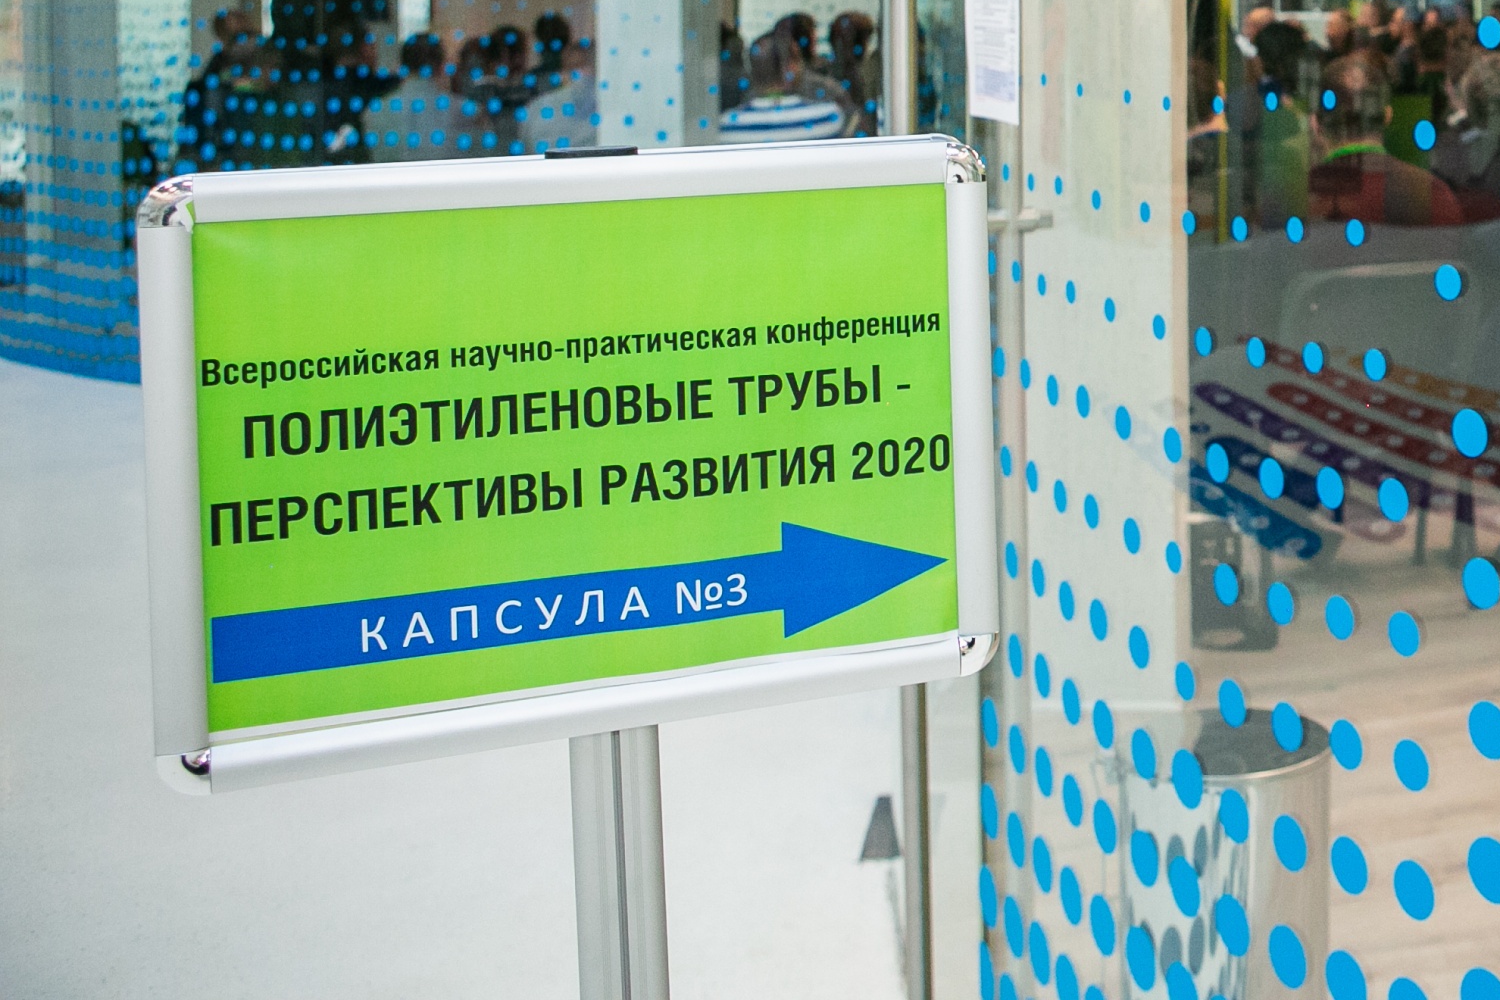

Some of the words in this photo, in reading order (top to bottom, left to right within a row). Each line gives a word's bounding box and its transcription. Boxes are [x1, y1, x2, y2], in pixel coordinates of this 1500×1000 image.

[201, 348, 440, 387] Всероссийская
[451, 326, 757, 372] научно-практическая
[766, 312, 940, 345] конференция
[243, 379, 714, 459] ПОЛИЭТИЛЕНОВЫЕ
[728, 364, 881, 416] ТРУБЫ
[210, 467, 584, 547] ПЕРСПЕКТИВЫ
[600, 442, 834, 506] РАЗВИТИЯ
[851, 433, 950, 480] 2020
[675, 573, 749, 614] №3
